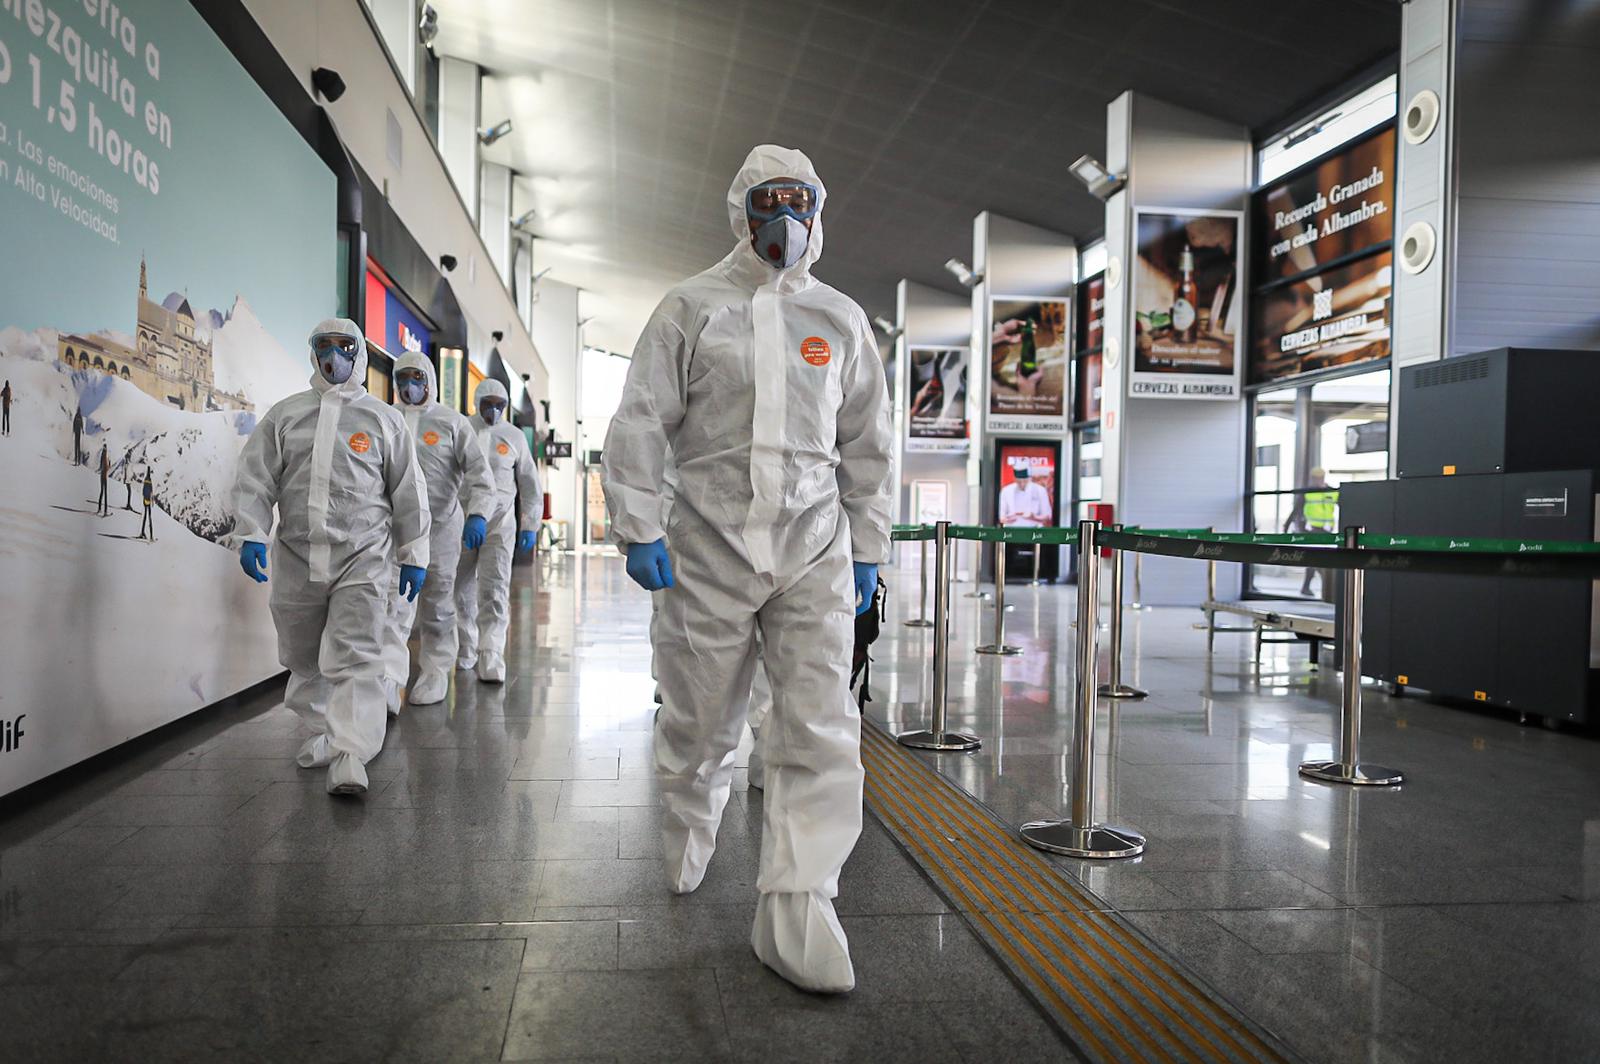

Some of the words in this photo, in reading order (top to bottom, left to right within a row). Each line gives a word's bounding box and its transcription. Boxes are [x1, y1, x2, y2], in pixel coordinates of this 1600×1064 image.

[145, 42, 160, 81] a
[28, 53, 77, 132] 1,5
[88, 101, 159, 195] horas
[145, 101, 171, 149] en
[18, 129, 43, 165] Las
[48, 155, 119, 214] emociones
[1275, 192, 1327, 231] Recuerda
[1328, 166, 1384, 205] Granada
[15, 165, 45, 201] Alta
[50, 183, 121, 246] Velocidad.
[1320, 200, 1387, 238] Alhambra.
[0, 713, 26, 752] if
